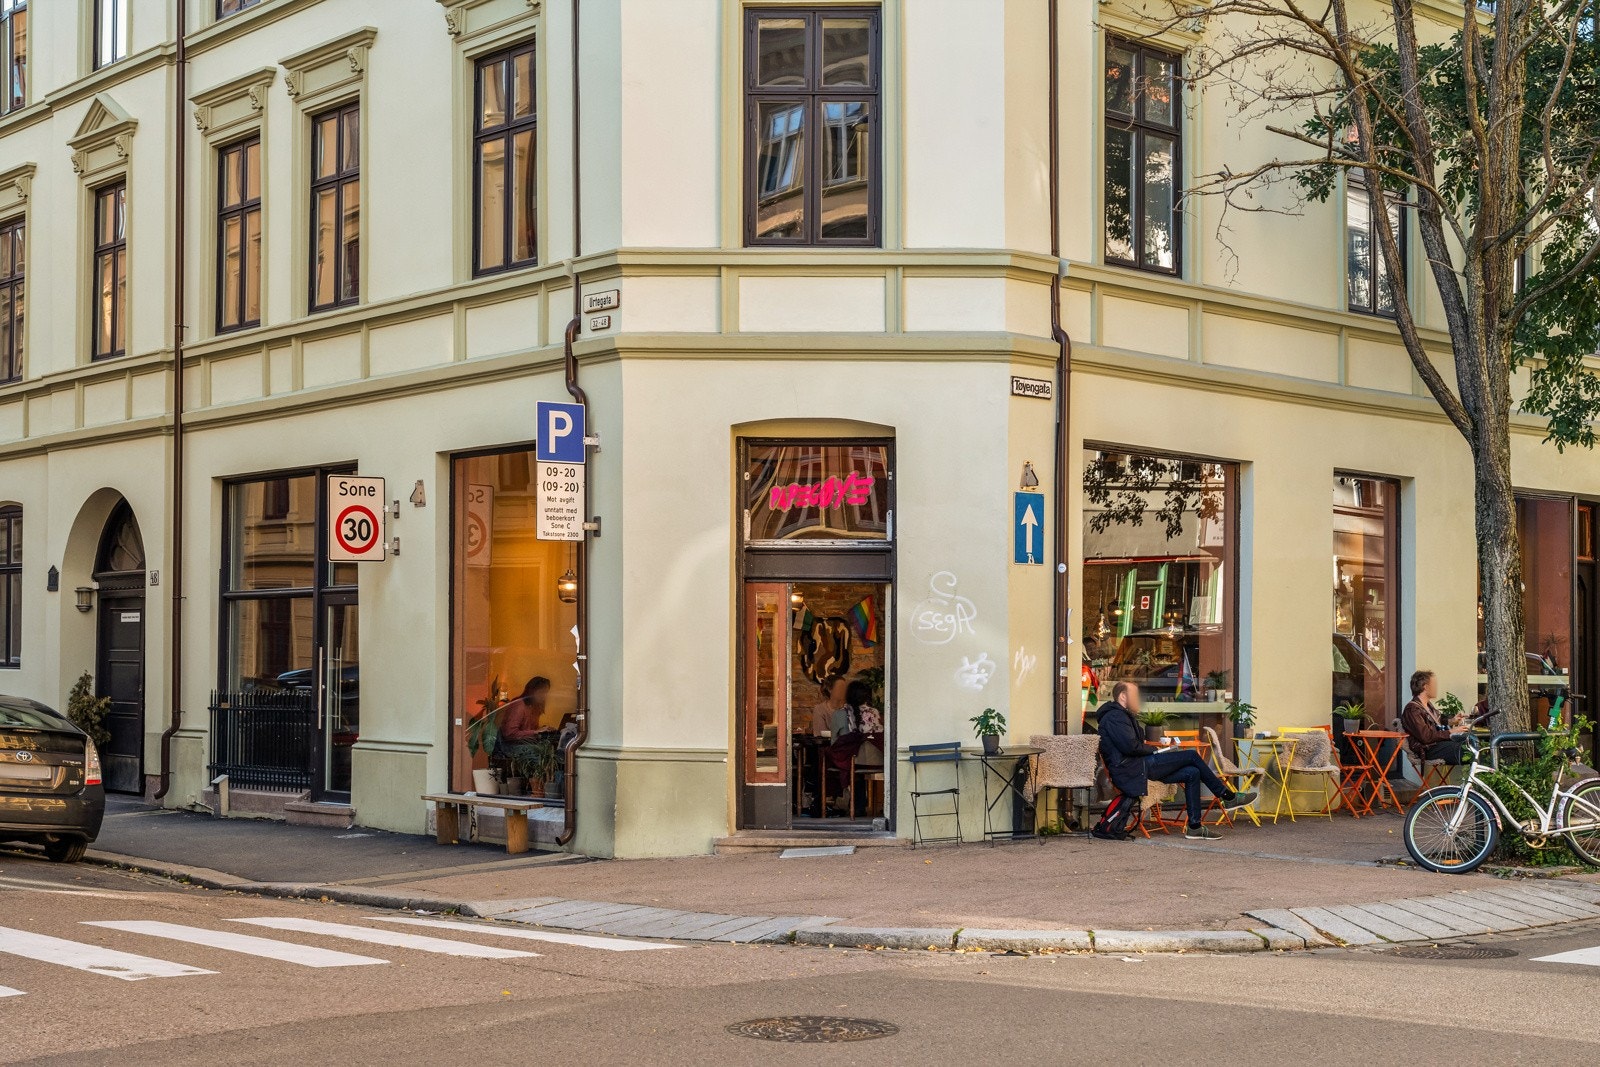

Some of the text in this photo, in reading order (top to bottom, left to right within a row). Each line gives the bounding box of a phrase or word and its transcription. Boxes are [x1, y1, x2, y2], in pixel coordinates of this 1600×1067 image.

[589, 295, 612, 308] Urtegata
[1014, 379, 1051, 395] Tøyengata
[548, 410, 573, 453] P
[339, 481, 376, 497] Sone
[559, 496, 575, 504] avgift
[343, 518, 371, 541] 30
